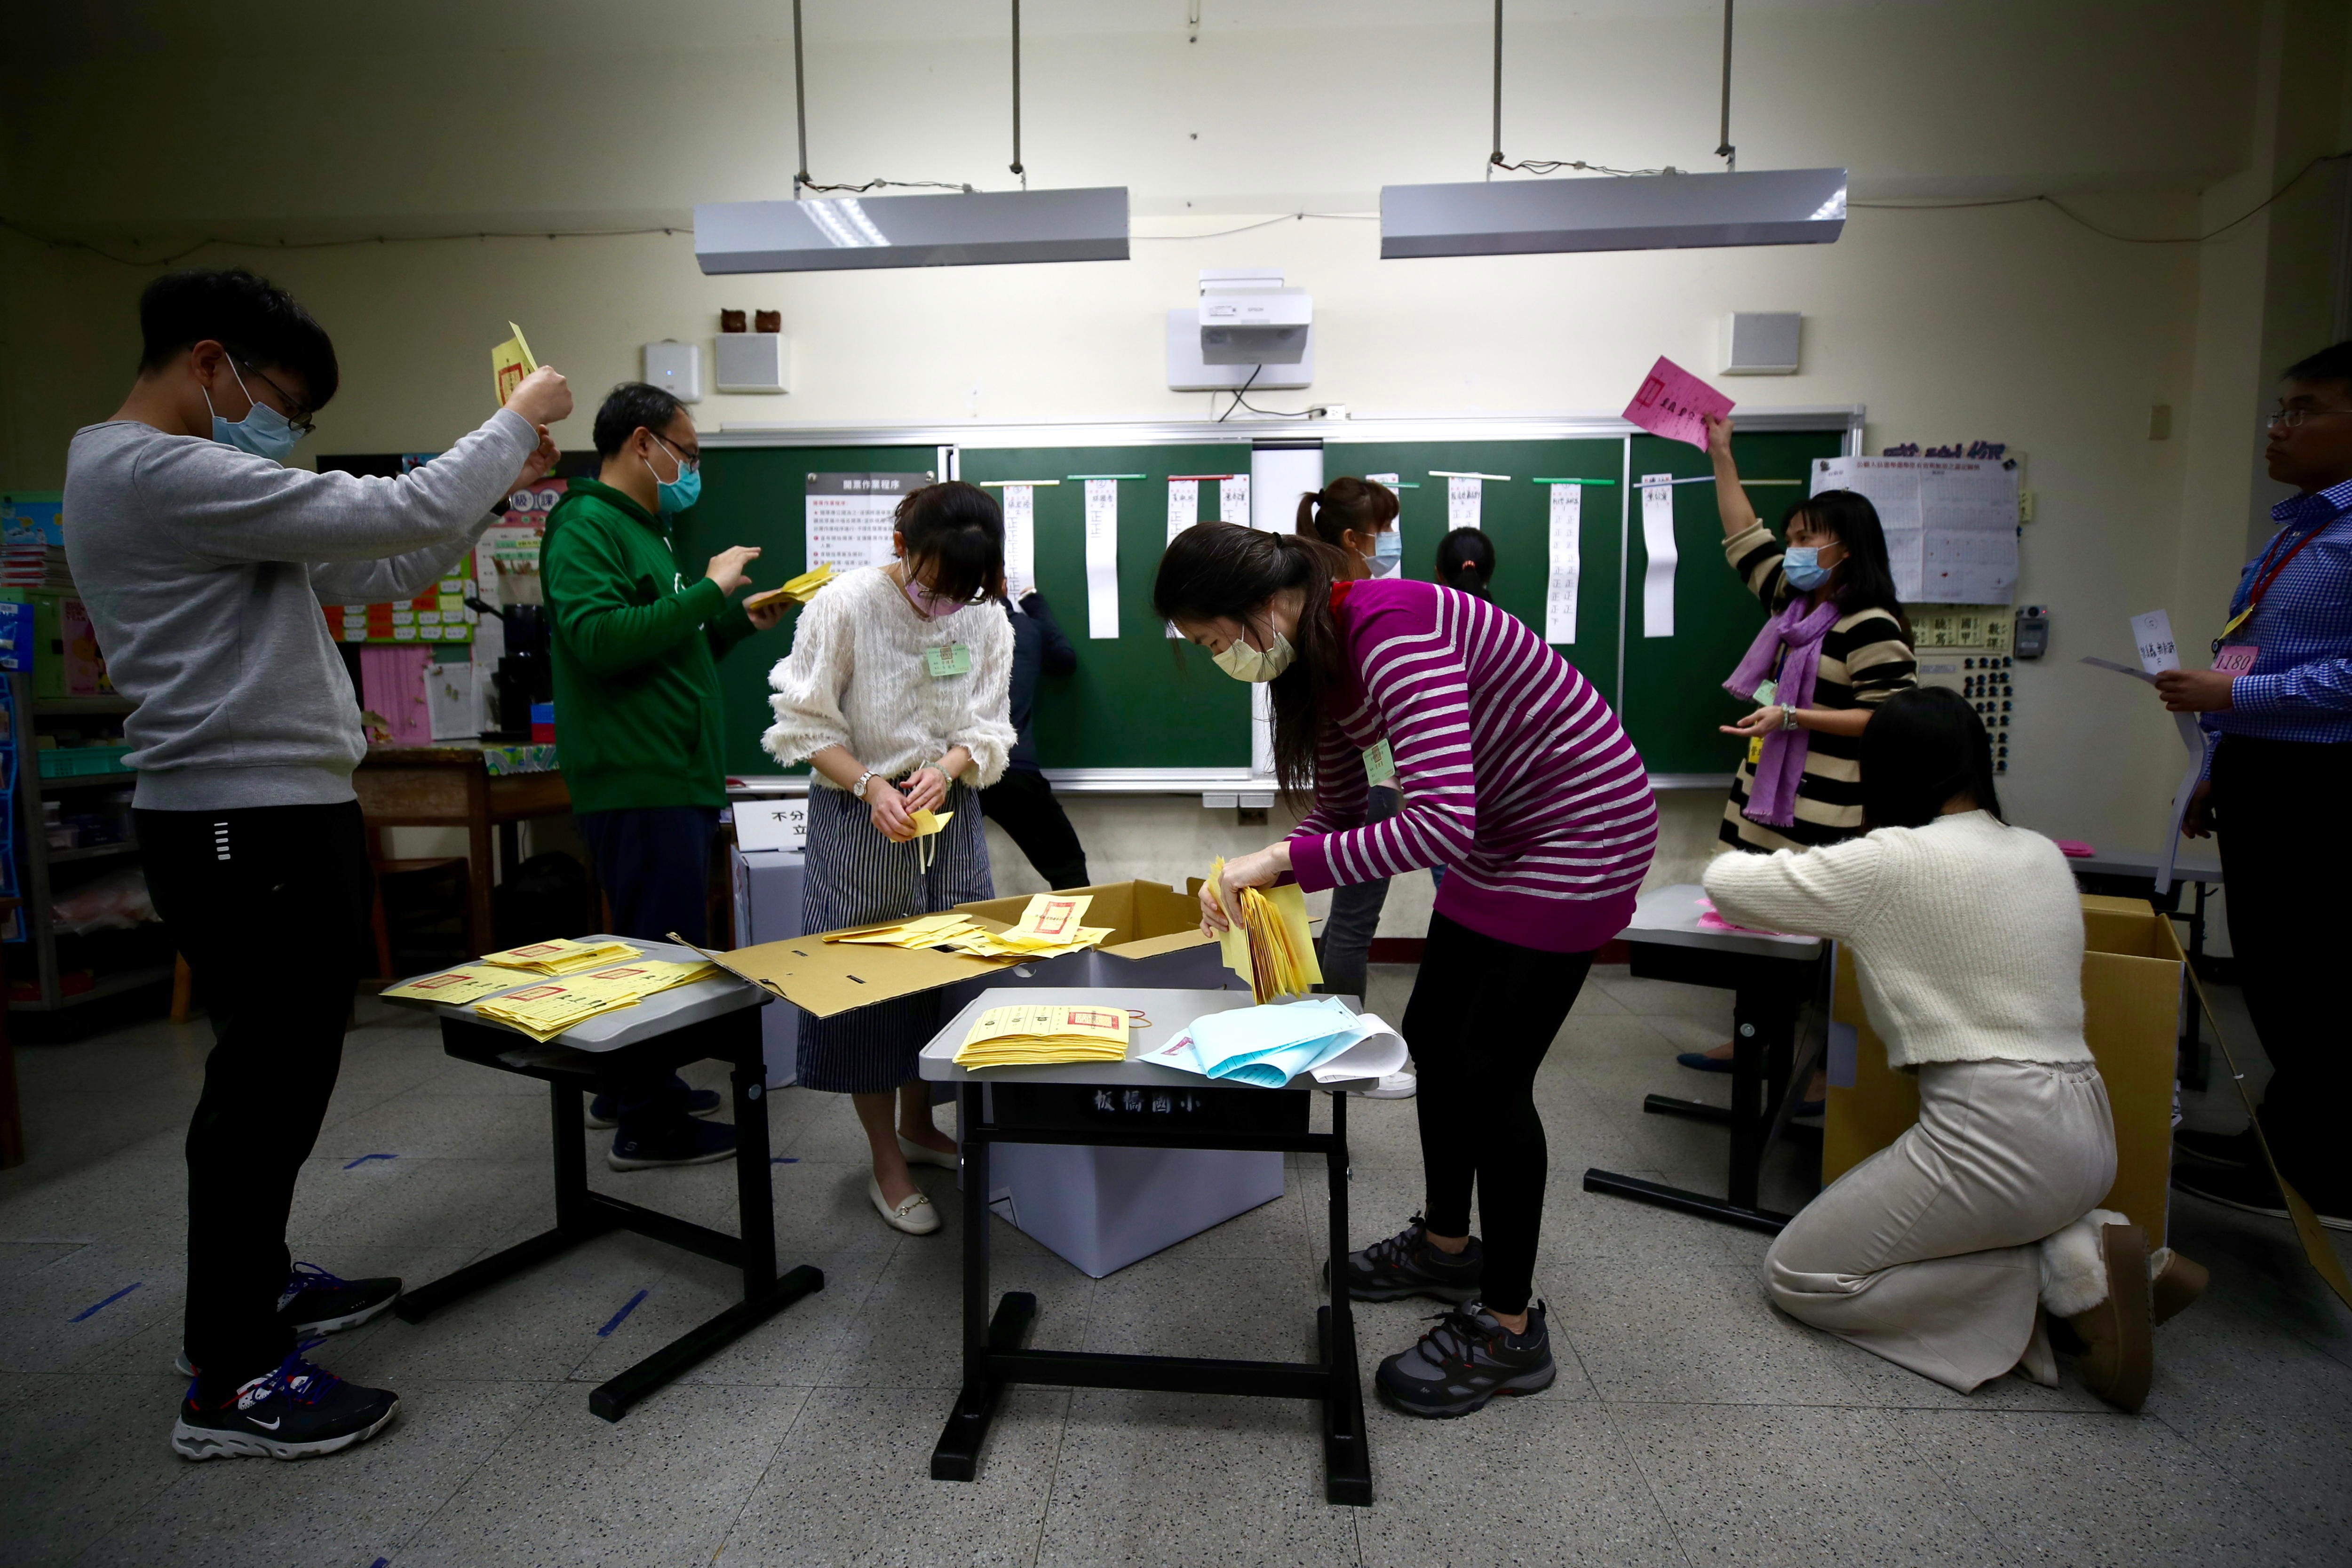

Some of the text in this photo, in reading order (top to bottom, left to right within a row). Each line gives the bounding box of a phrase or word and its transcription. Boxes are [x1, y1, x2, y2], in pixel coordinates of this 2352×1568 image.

[843, 479, 900, 490] 開票作業程序
[2215, 654, 2251, 670] 1180
[793, 825, 806, 835] 立
[1095, 1090, 1200, 1114] 板橋國小
